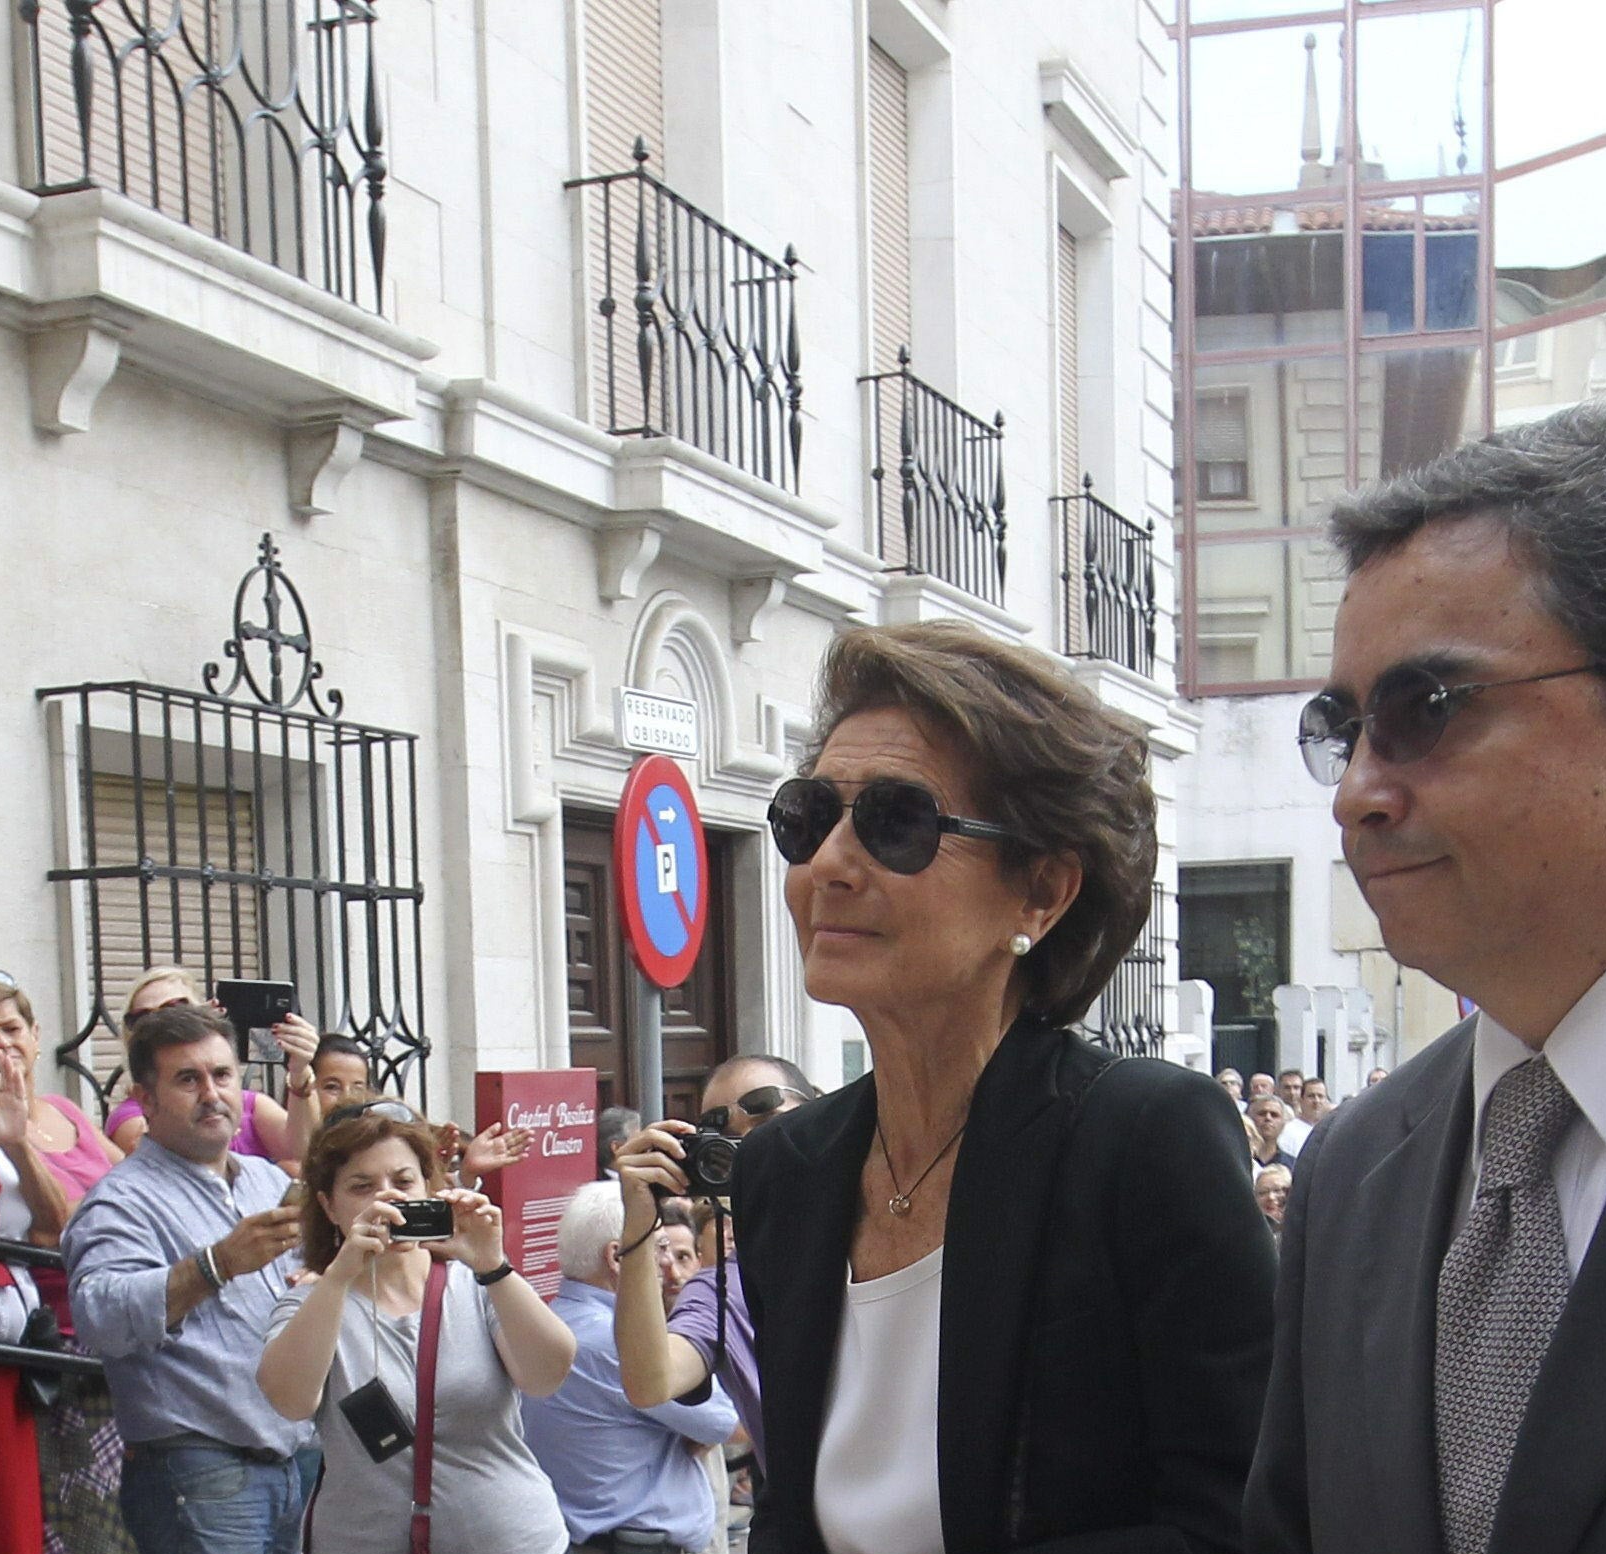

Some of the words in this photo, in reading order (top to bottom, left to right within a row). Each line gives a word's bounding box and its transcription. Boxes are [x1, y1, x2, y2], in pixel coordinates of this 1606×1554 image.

[627, 697, 693, 725] RESERVADO
[633, 726, 691, 748] OBISPADO
[662, 851, 673, 887] P
[507, 1102, 554, 1129] Catedral
[542, 1130, 583, 1157] Claustro
